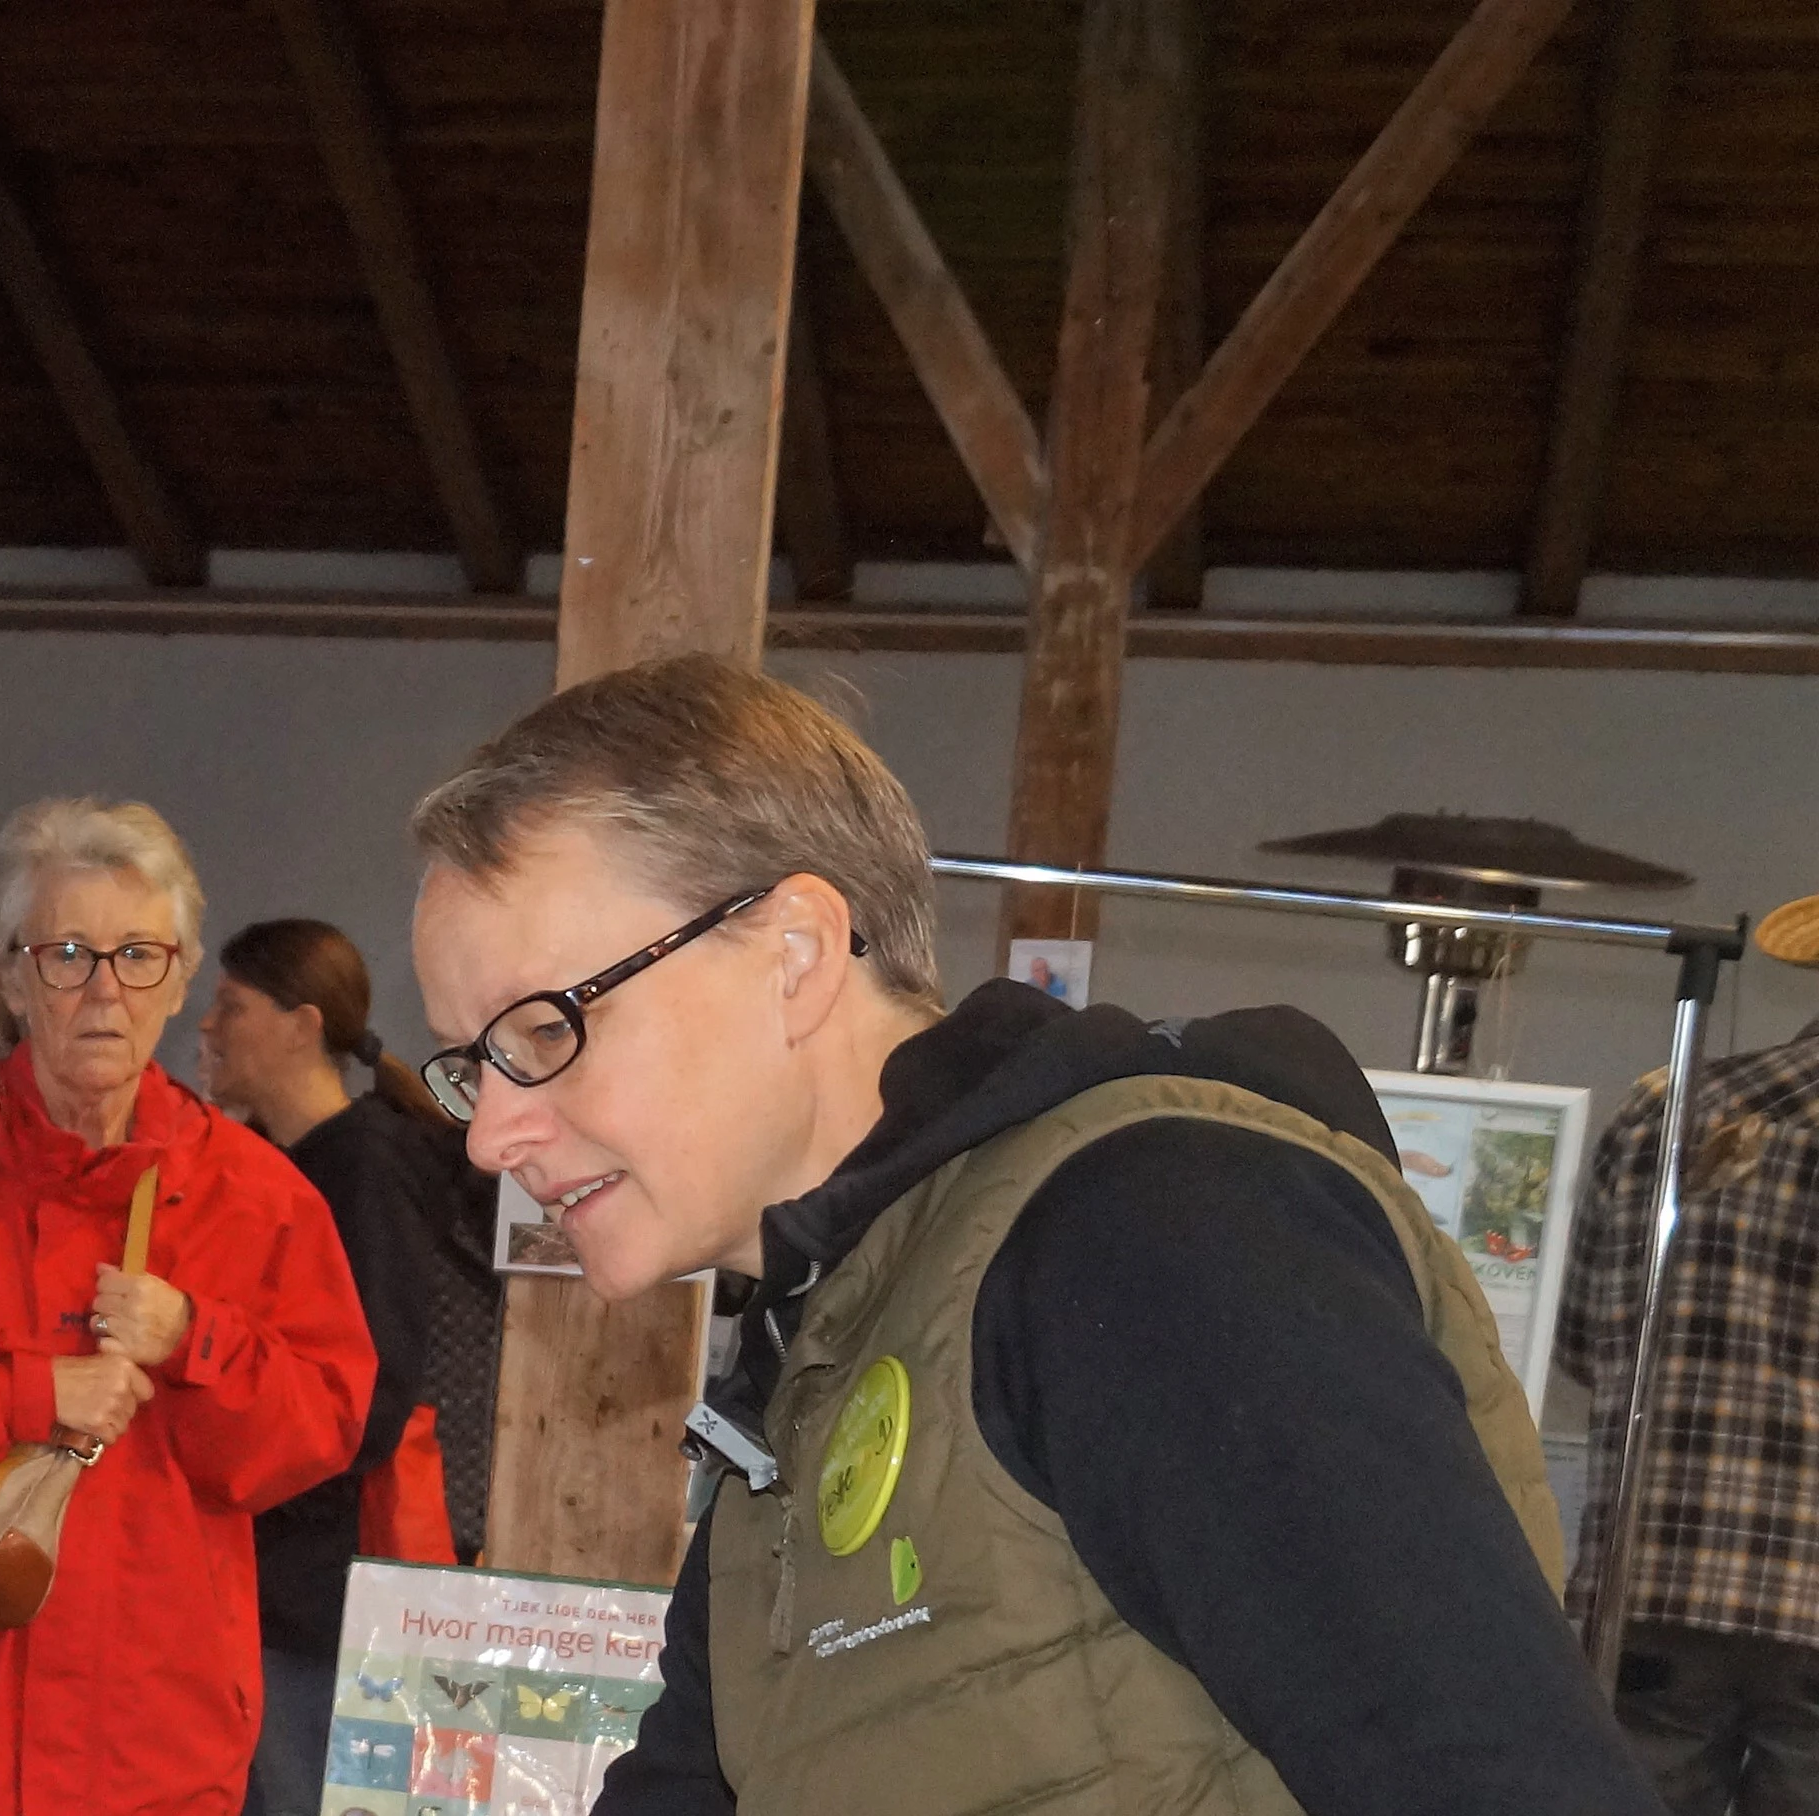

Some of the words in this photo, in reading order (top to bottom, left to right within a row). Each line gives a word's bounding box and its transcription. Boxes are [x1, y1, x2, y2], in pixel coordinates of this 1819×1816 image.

[502, 1599, 540, 1614] TJEK
[626, 1612, 657, 1627] HER
[400, 1608, 478, 1641] Hvor
[486, 1621, 595, 1659] mange
